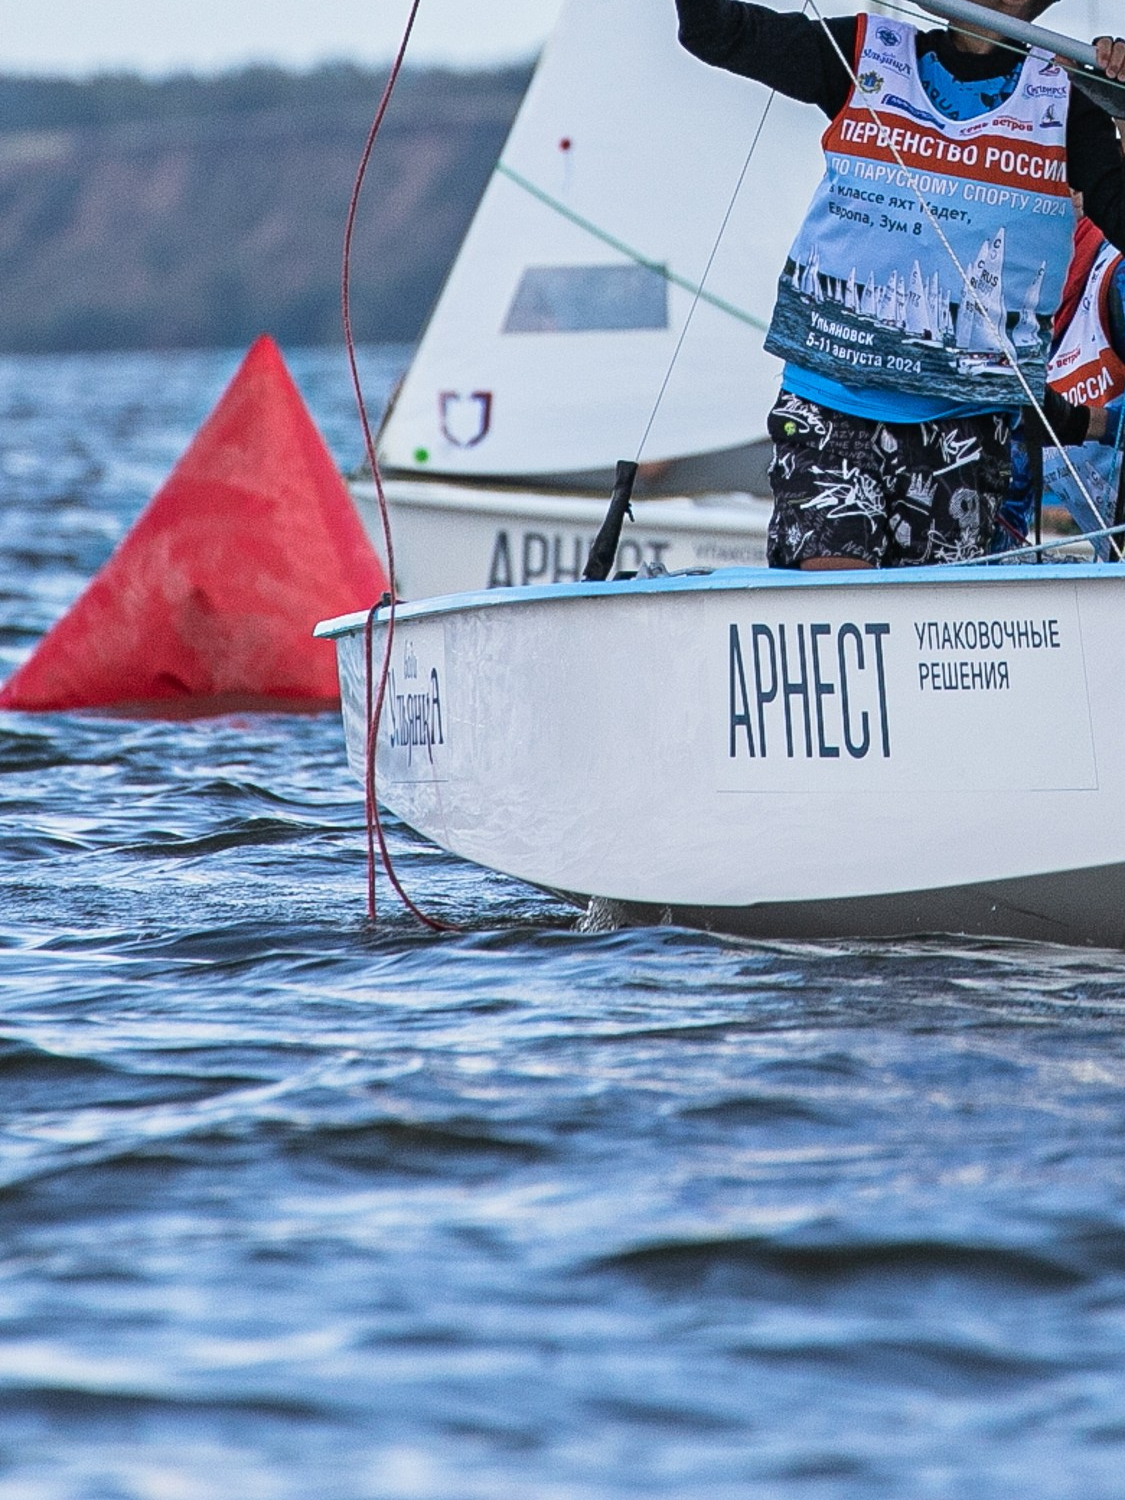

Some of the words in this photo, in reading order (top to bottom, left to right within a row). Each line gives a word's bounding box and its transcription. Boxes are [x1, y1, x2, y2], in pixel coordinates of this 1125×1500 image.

[840, 118, 978, 166] ПЕРВЕНСТВО
[831, 157, 850, 176] ПО
[854, 161, 959, 197] ПАРУСНОМУ
[963, 183, 1030, 211] СПОРТУ
[1032, 197, 1067, 218] 2024
[837, 185, 885, 204] классе
[888, 196, 916, 211] яхт
[828, 201, 875, 228] Европа,
[879, 214, 908, 233] Зум
[912, 221, 923, 235] 8
[806, 332, 830, 353] 5-11
[832, 344, 882, 367] августа
[886, 355, 921, 374] 2024
[728, 622, 892, 759] АРНЕСТ
[913, 619, 1062, 651] УПАКОВОЧНЫЕ
[917, 660, 1011, 691] РЕШЕНИЯ
